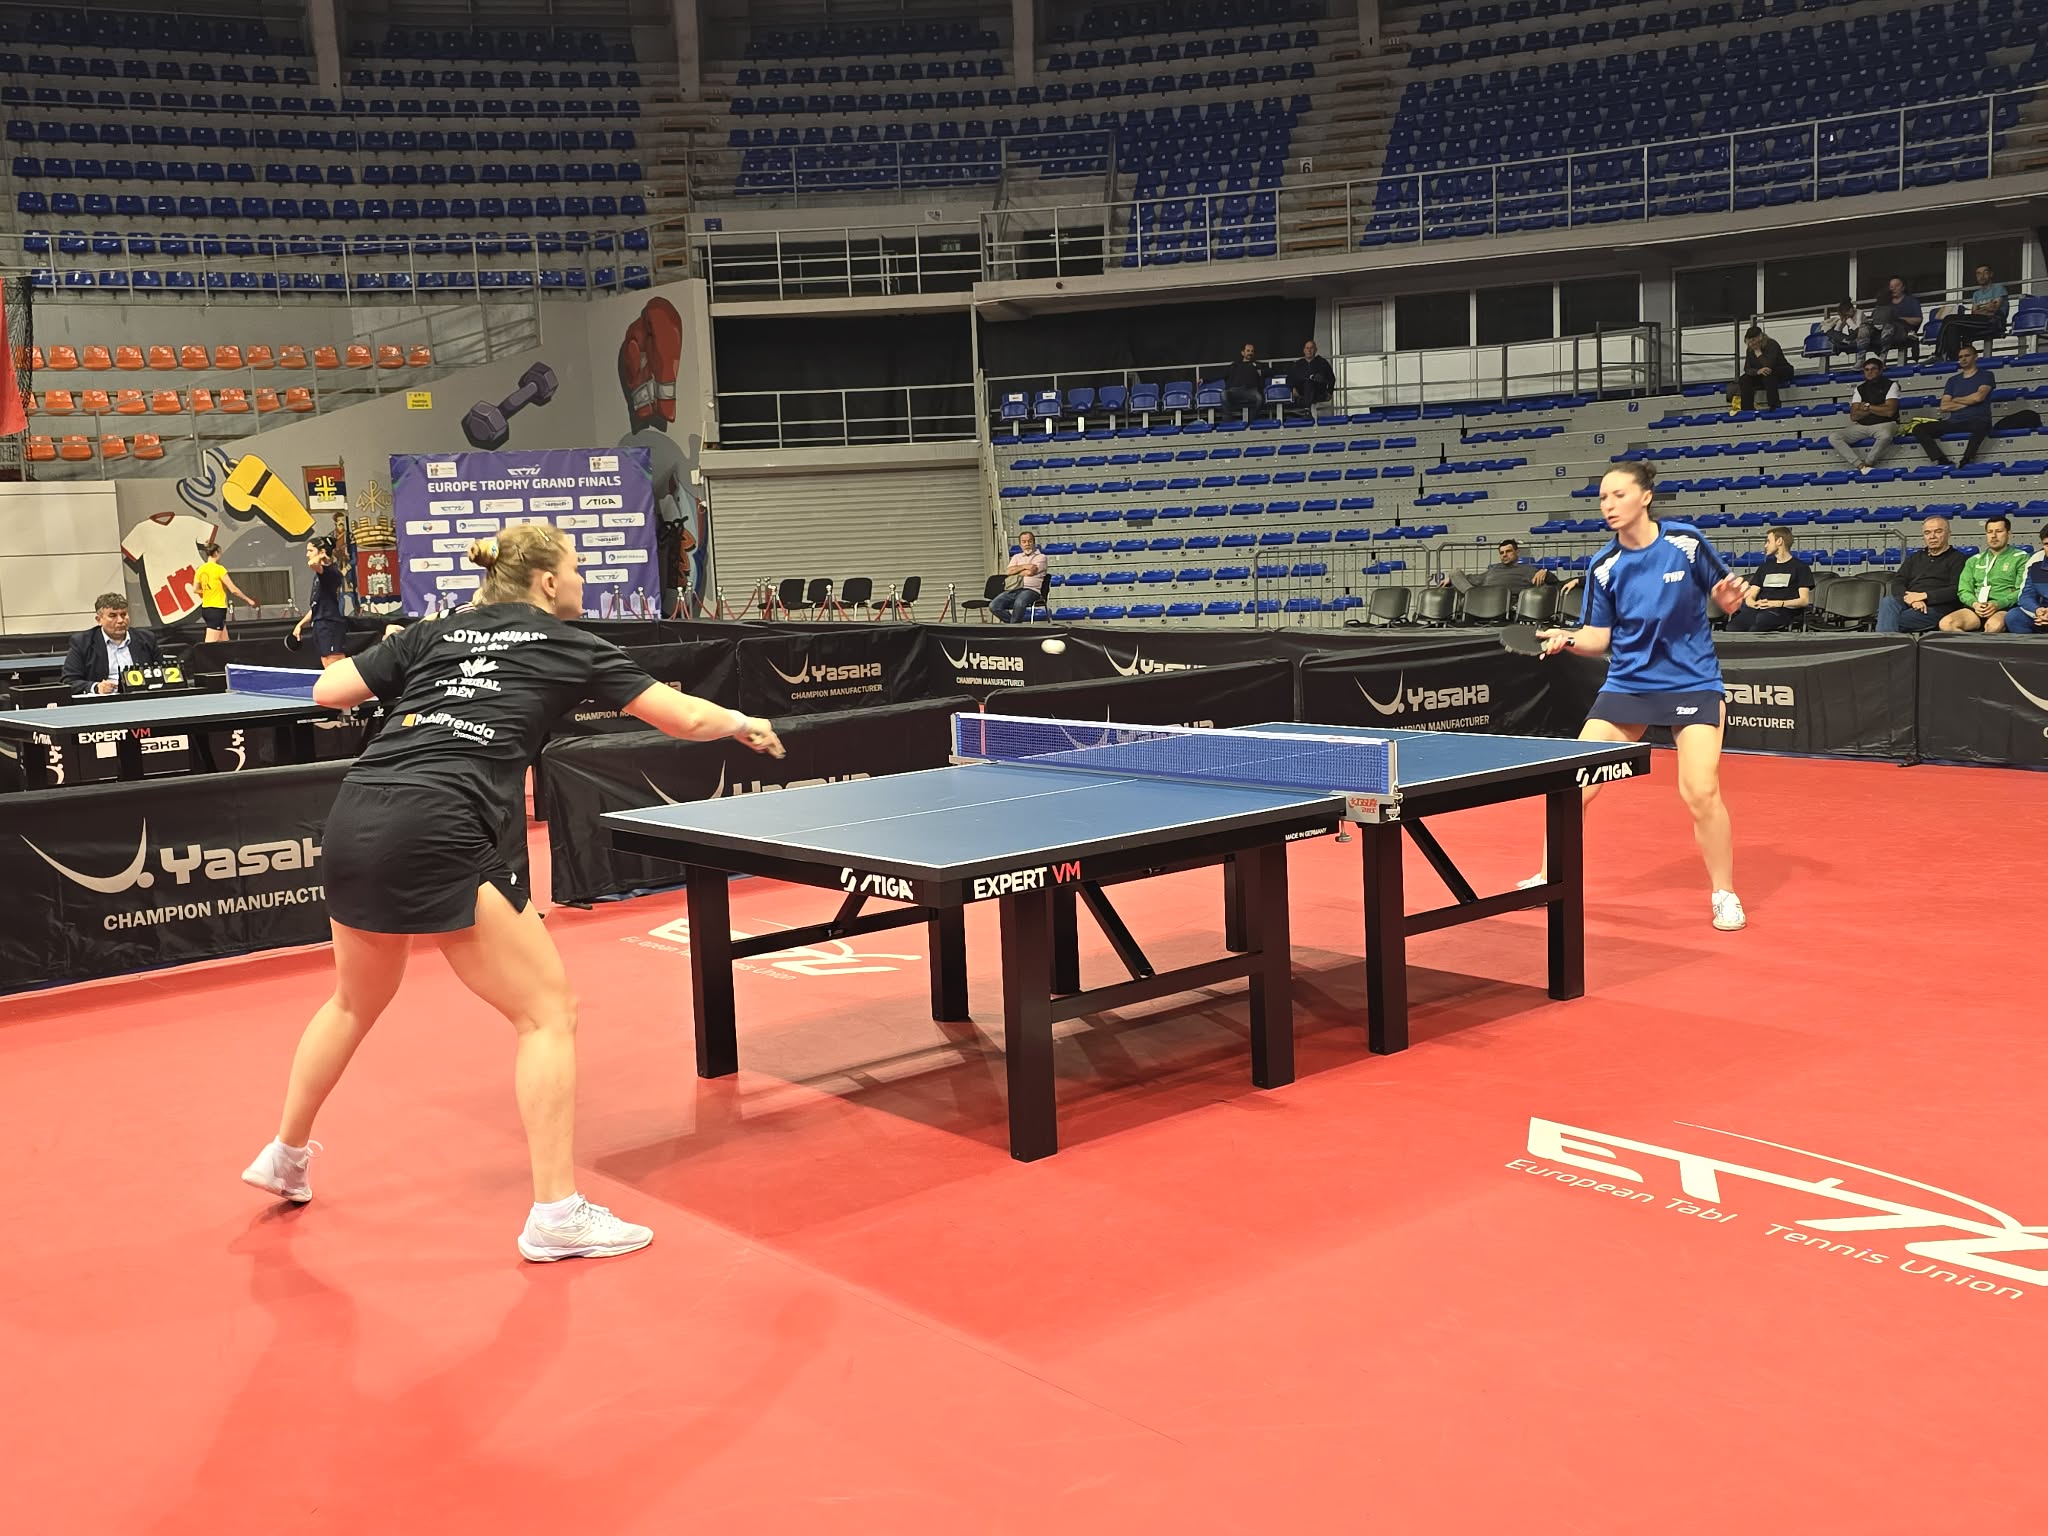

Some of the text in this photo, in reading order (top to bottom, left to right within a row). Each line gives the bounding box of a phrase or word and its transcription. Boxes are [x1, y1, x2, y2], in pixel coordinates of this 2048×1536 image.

[428, 475, 622, 493] EUROPE TROPHY GRAND FINALS
[586, 498, 616, 506] STIGA
[969, 652, 1023, 672] Yasaka
[128, 670, 144, 686] 0
[165, 667, 182, 682] 2
[811, 662, 882, 683] Yasaka
[956, 676, 1025, 687] CHAMPION MANUFACTURER
[791, 684, 883, 700] CHAMPION MANUFACTURER
[1407, 684, 1490, 712] Yasaka
[1724, 683, 1795, 706] saka
[575, 711, 618, 722] CHAMPION
[1428, 715, 1490, 731] MANUFACTURER
[1727, 715, 1795, 729] UFACTURER
[78, 727, 151, 744] EXPERT VM
[141, 740, 180, 751] saka
[1592, 761, 1633, 783] STIGA
[1285, 832, 1298, 840] MADE
[1305, 827, 1327, 837] GERMANY
[160, 838, 323, 884] Yasak
[858, 874, 914, 900] STIGA
[974, 861, 1081, 899] EXPERT VM
[103, 901, 211, 931] CHAMPION
[1505, 1158, 1655, 1203] European
[1764, 1224, 1890, 1265] Tennis
[1899, 1259, 2024, 1301] Union
